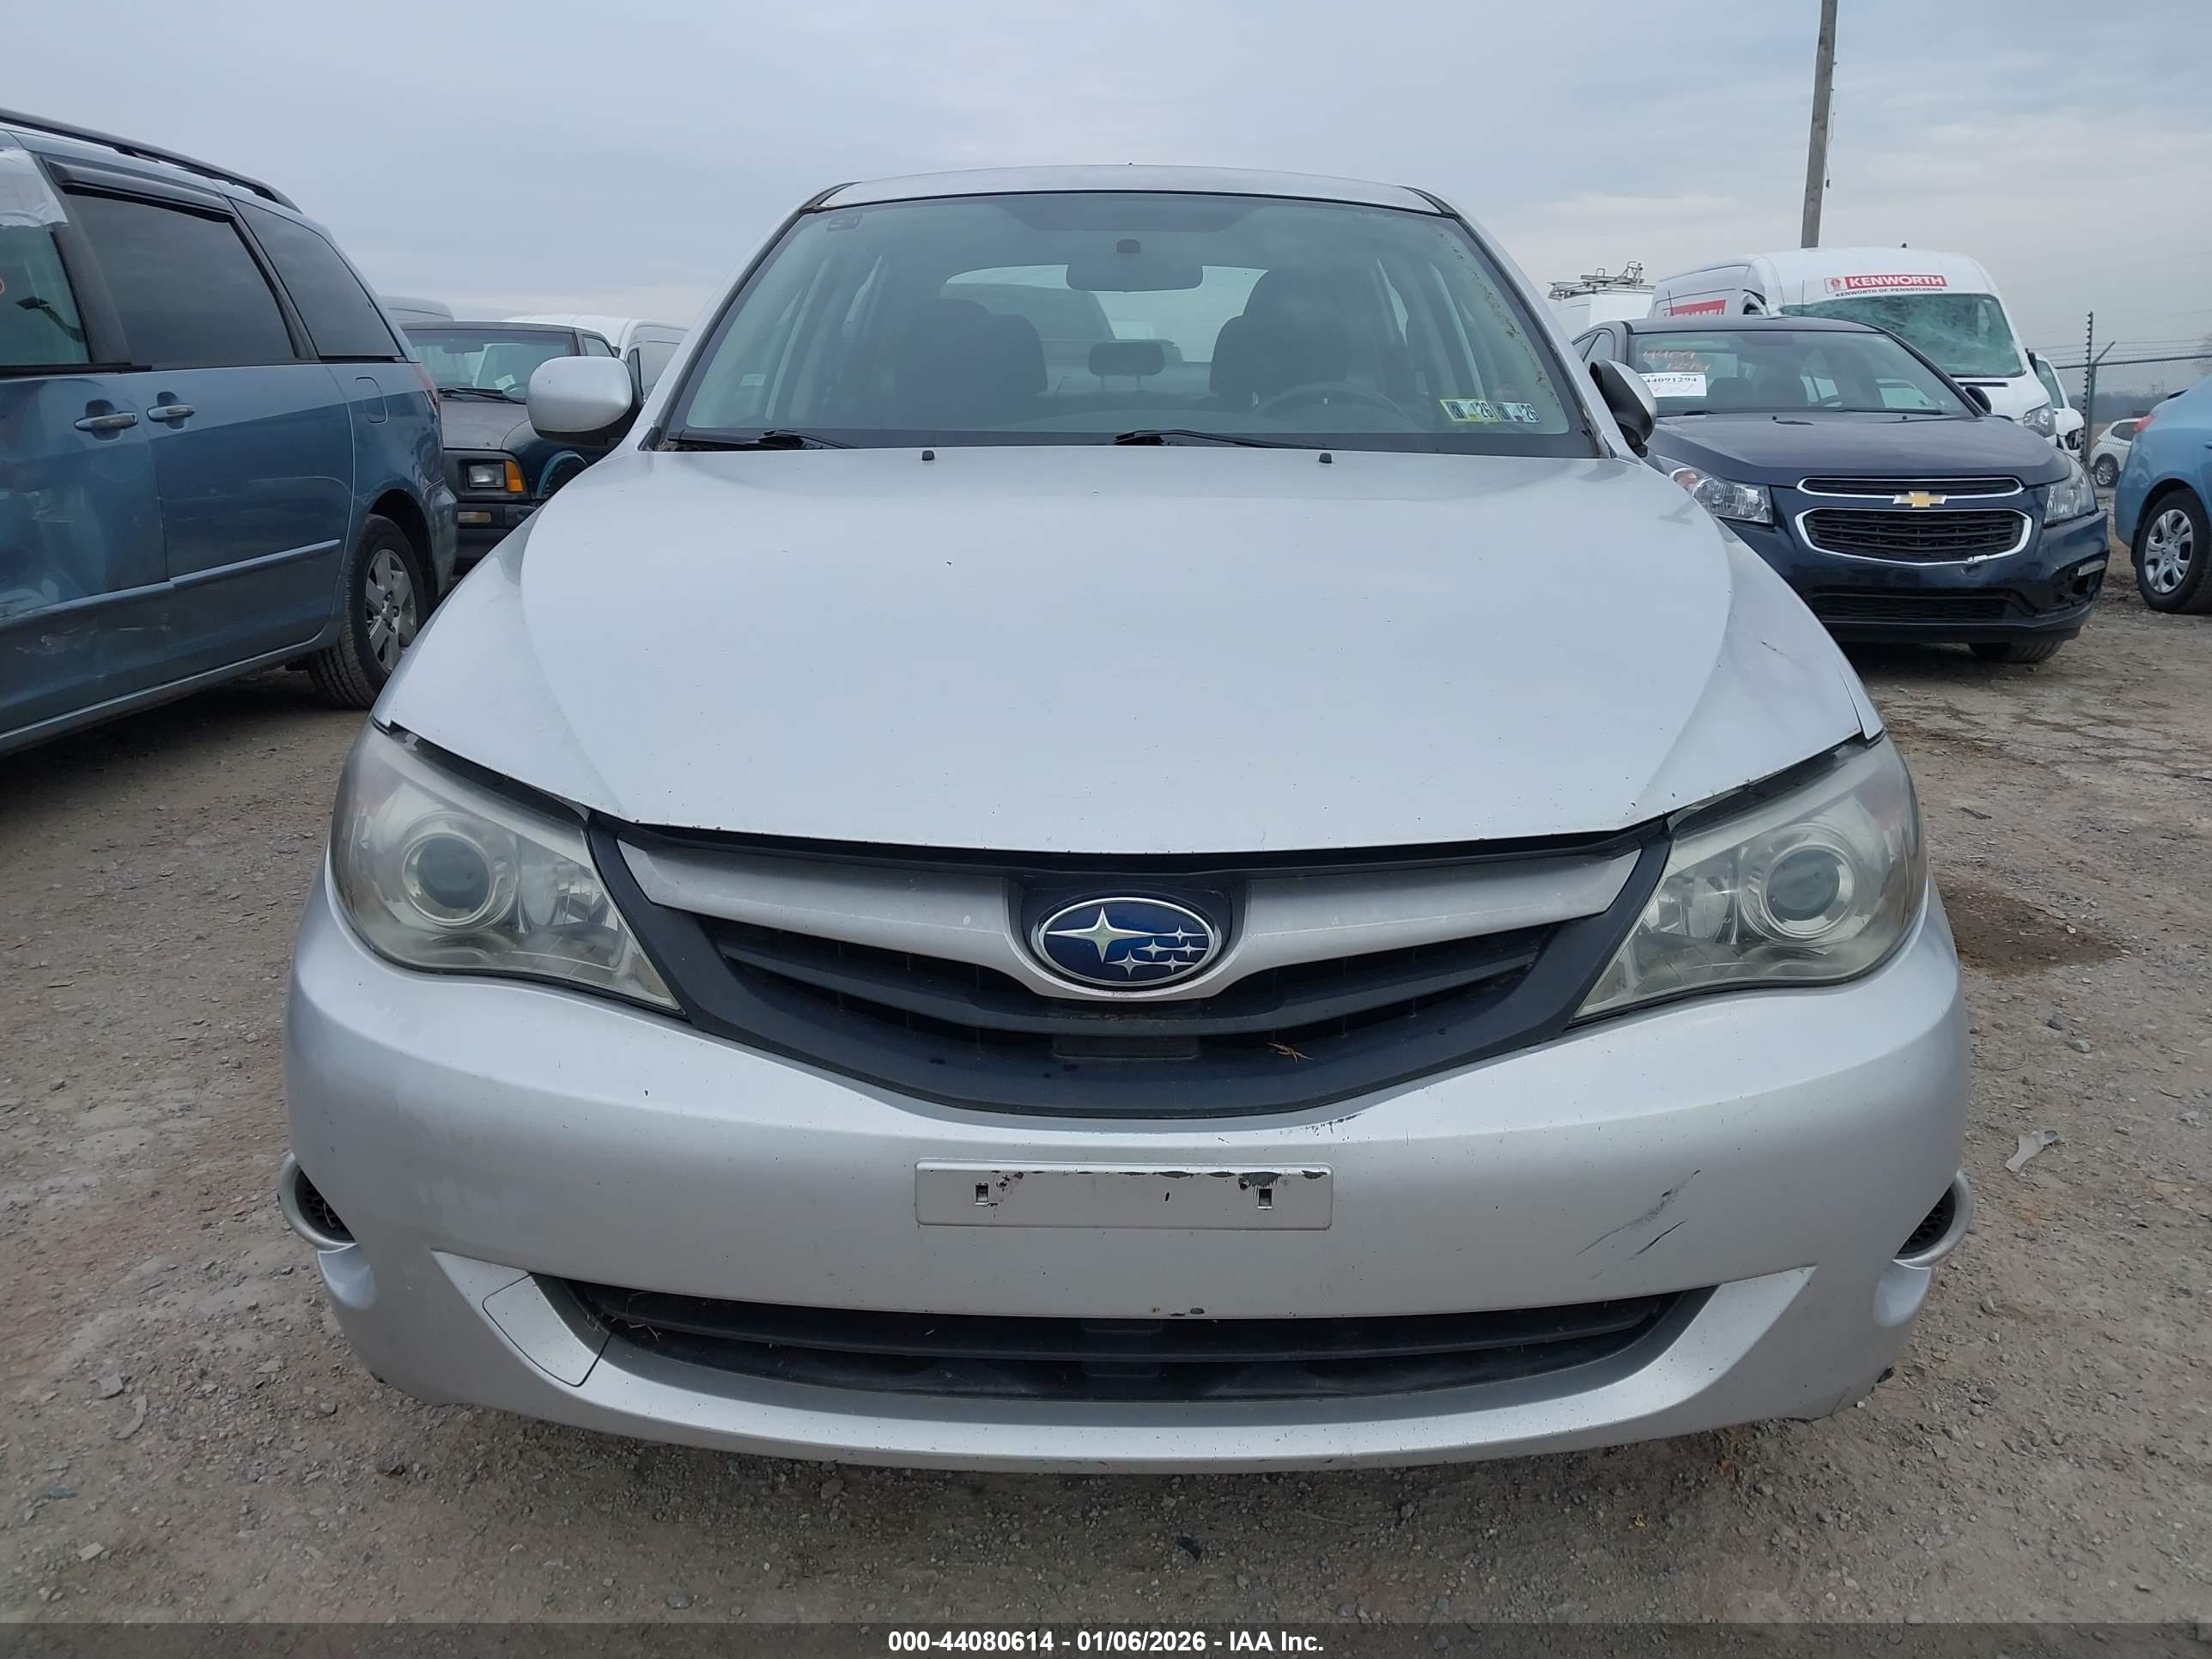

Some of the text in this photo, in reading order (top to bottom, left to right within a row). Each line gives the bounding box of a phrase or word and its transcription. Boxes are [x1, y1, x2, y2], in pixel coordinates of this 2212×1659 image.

[1850, 275, 1943, 288] KENWORTH
[1835, 289, 1877, 297] KENWORTH
[1474, 402, 1494, 418] 26
[1520, 404, 1540, 421] 26
